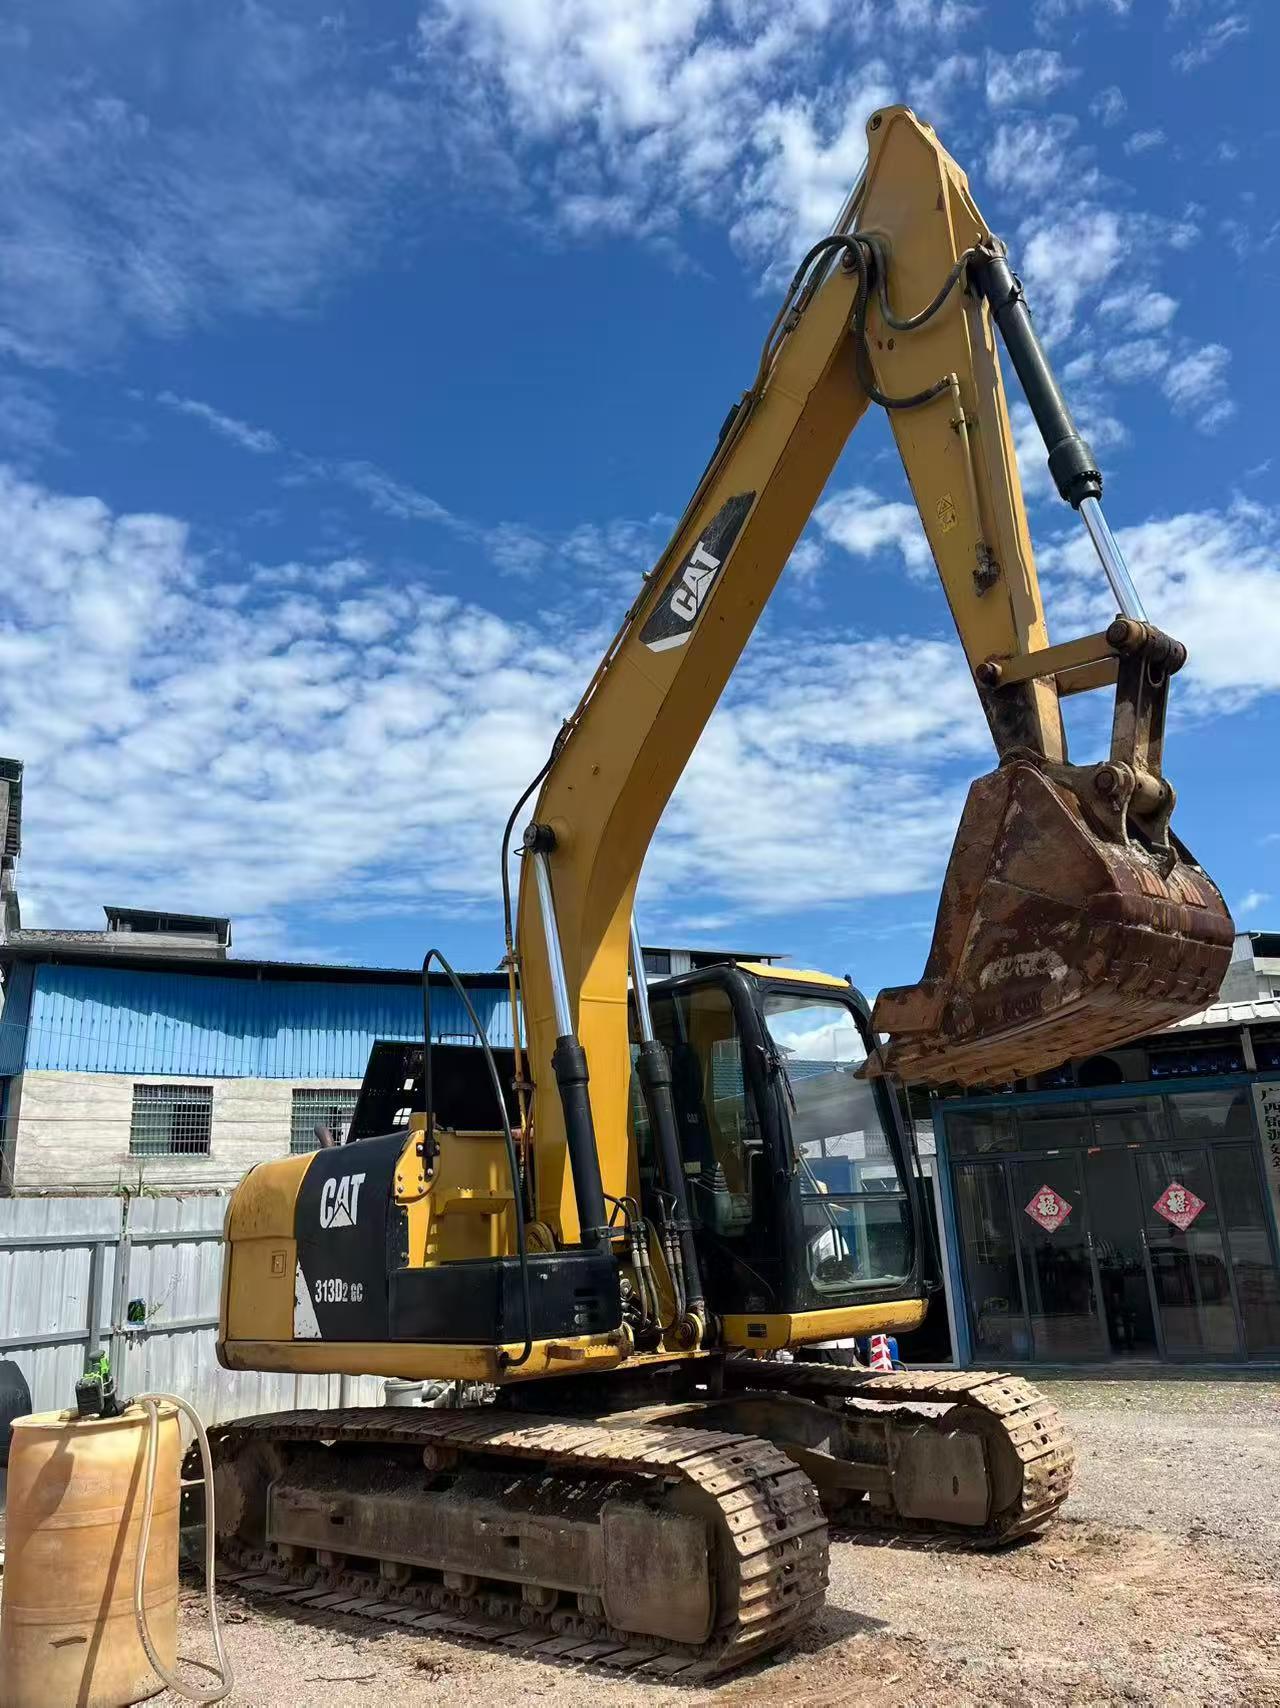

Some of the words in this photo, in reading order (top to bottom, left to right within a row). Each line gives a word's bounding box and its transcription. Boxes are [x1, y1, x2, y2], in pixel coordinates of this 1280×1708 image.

[670, 541, 721, 622] CAT
[320, 1173, 366, 1229] CAT
[1037, 1194, 1059, 1216] 福
[315, 1278, 348, 1303] 313D2
[350, 1282, 363, 1302] GC
